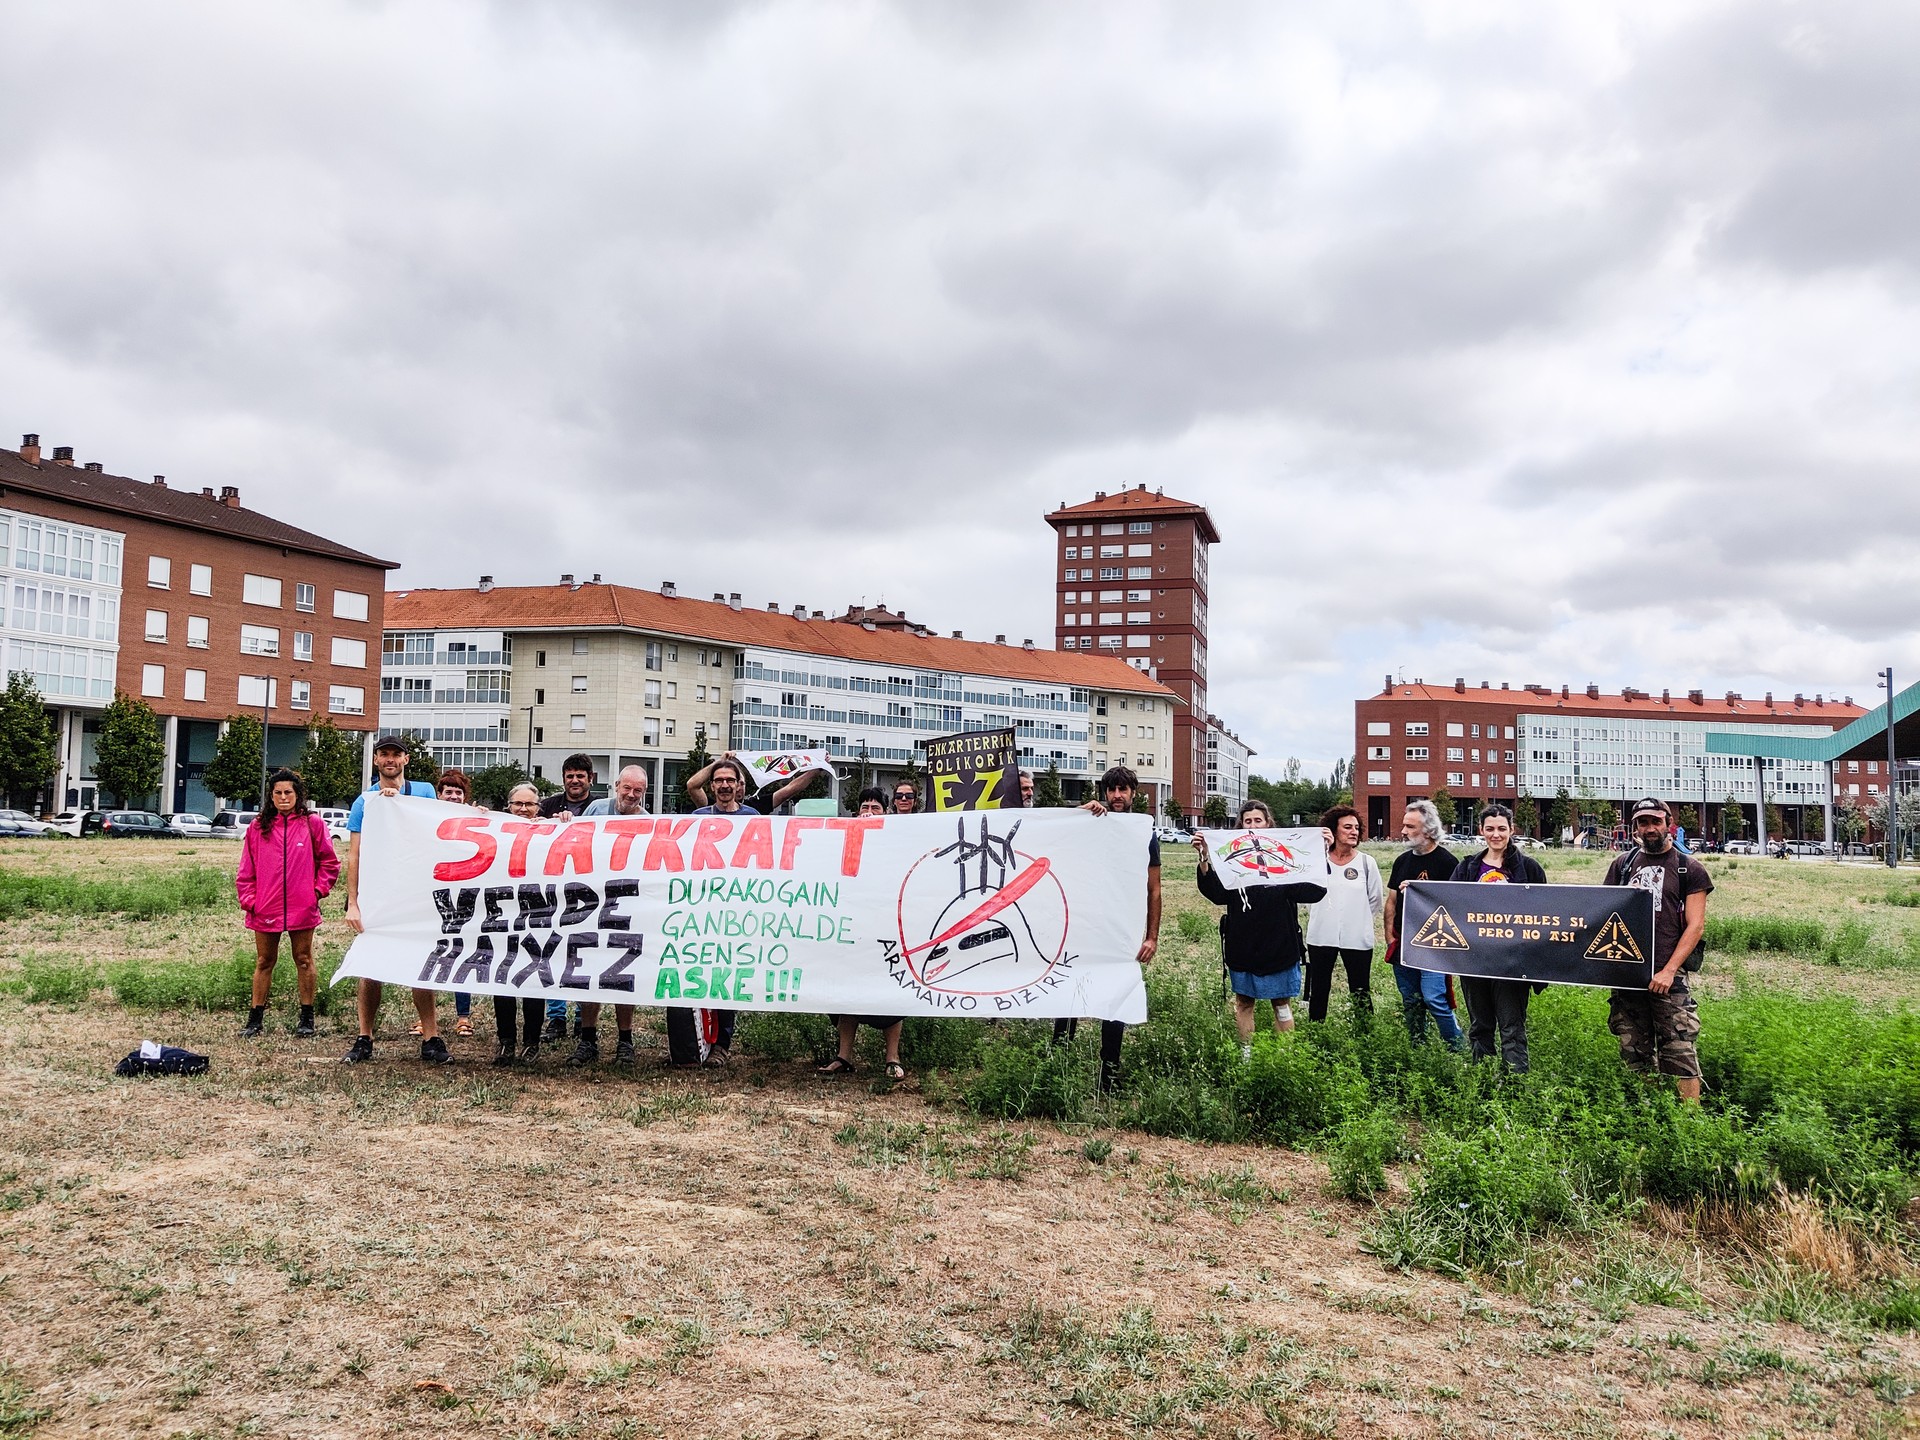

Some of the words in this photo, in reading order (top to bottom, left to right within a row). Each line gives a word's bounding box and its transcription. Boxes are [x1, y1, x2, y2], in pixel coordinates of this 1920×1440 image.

[927, 751, 1015, 774] EOLIKORIK
[932, 767, 1006, 813] EZ
[433, 816, 885, 881] STATKRAFT
[432, 879, 640, 934] VENDE
[668, 877, 839, 907] DURAKOGAIN
[661, 910, 855, 944] GANBORALDE
[1467, 912, 1561, 926] RENOVABLES
[1478, 927, 1515, 938] PERO
[1522, 929, 1541, 940] NO
[659, 942, 789, 966] ASENSIO
[1432, 938, 1448, 947] EZ
[1606, 949, 1623, 959] EZ
[418, 930, 643, 992] HAIXEZ
[654, 967, 755, 1002] ASKE
